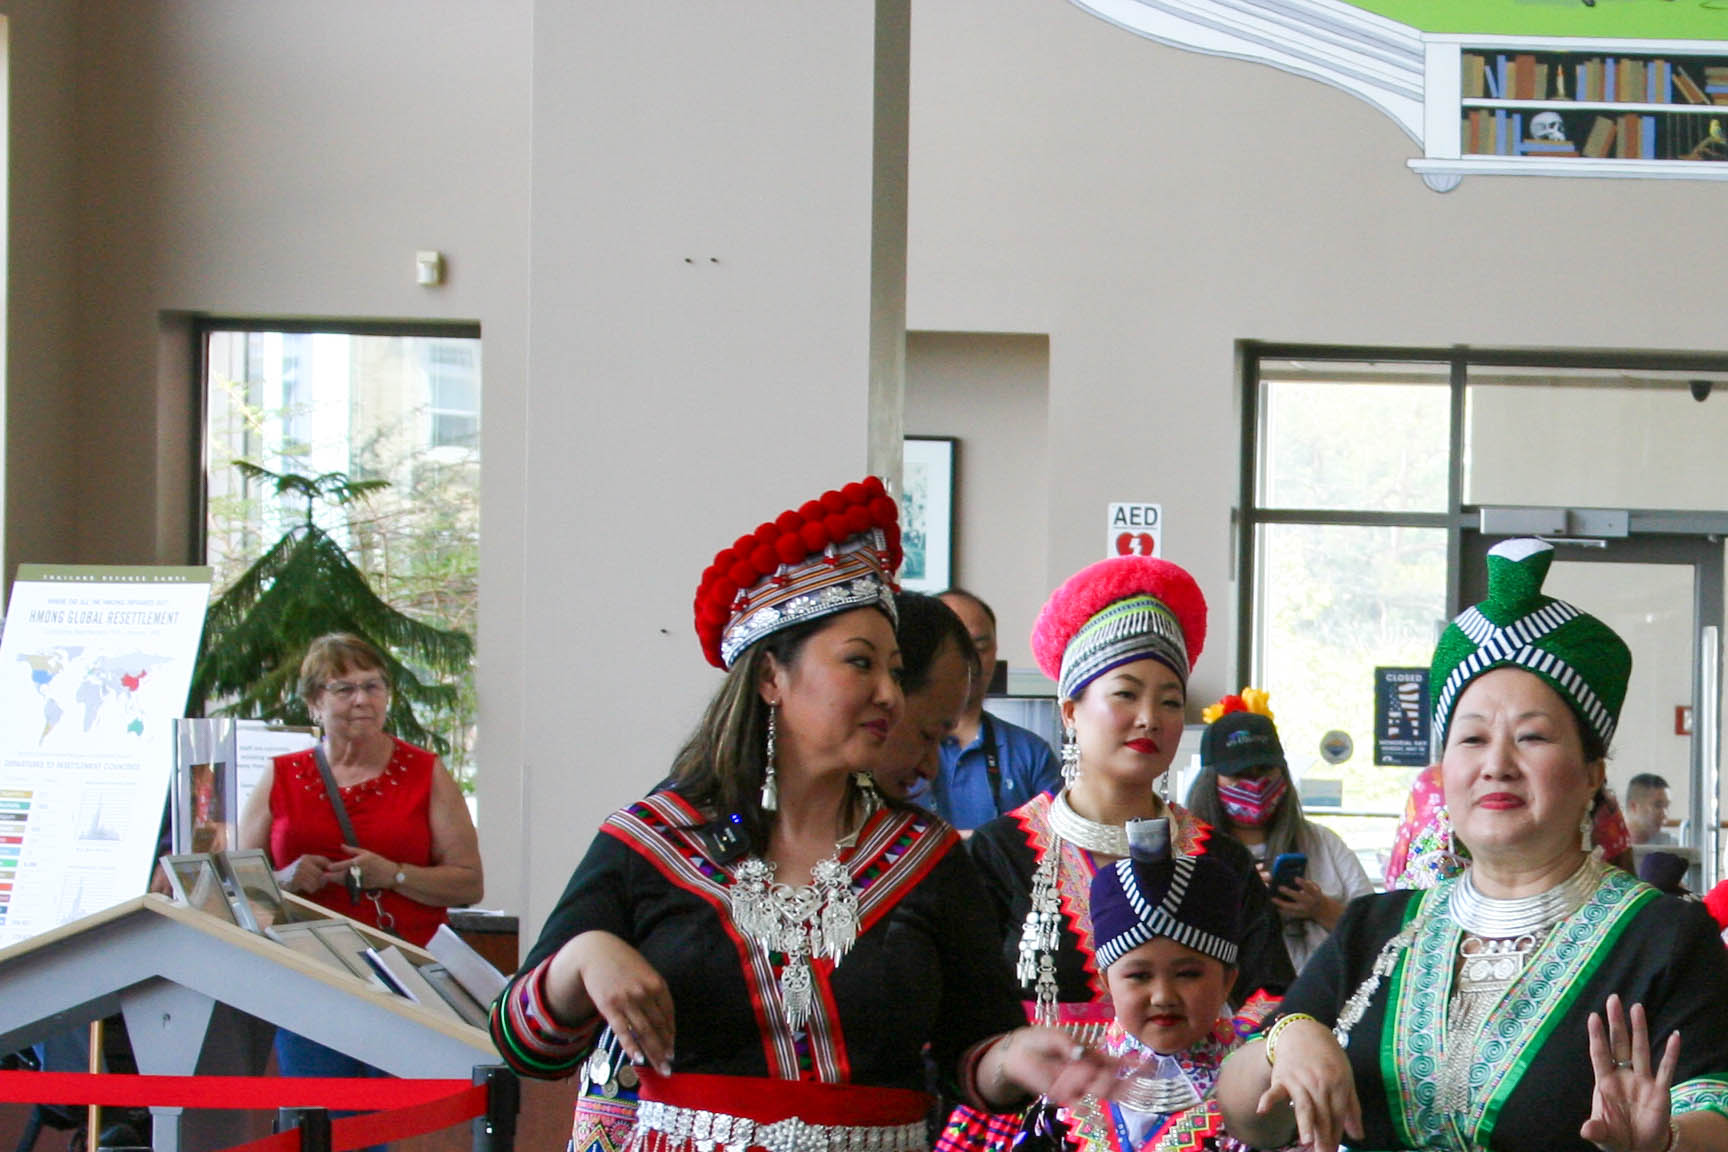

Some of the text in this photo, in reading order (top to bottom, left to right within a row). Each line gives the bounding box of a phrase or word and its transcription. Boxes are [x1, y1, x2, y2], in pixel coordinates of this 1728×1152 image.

[1113, 506, 1158, 526] AED
[29, 610, 180, 626] HMONG GLOBAL RESETTLEMENT
[1385, 673, 1423, 682] CLOSED
